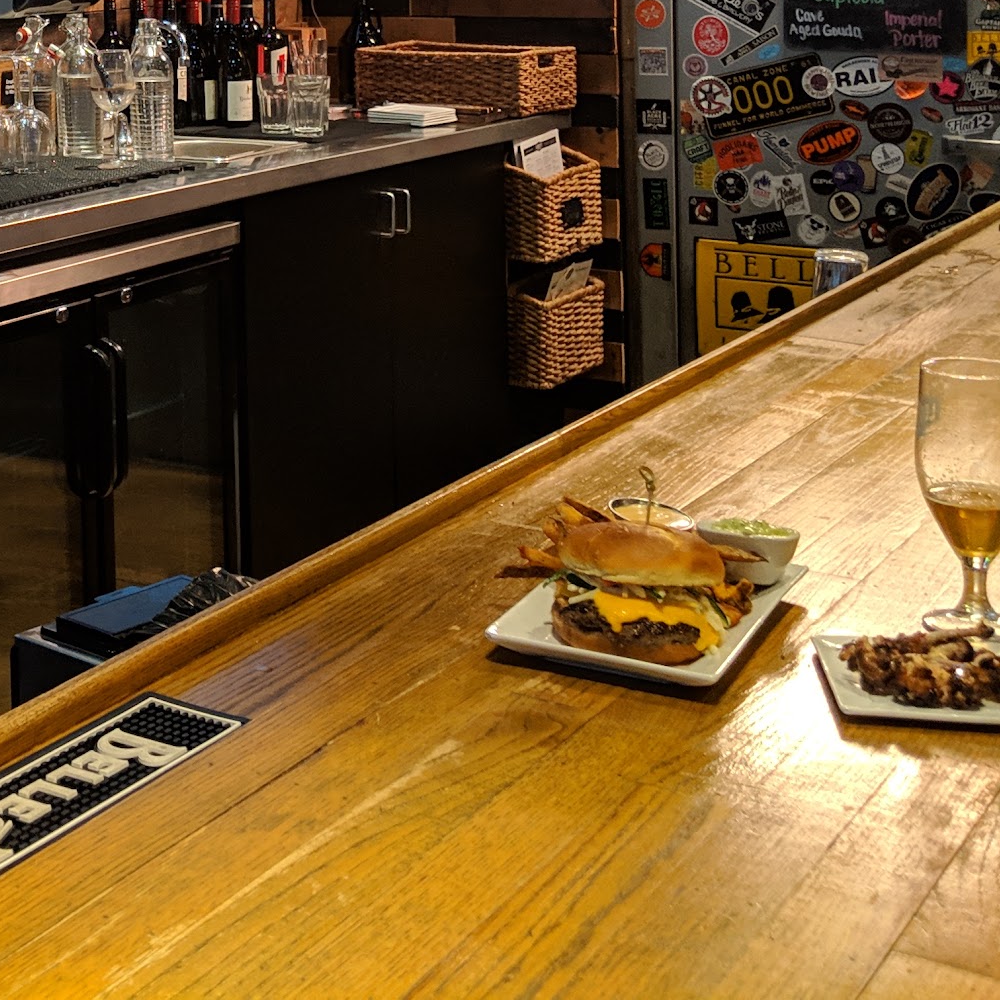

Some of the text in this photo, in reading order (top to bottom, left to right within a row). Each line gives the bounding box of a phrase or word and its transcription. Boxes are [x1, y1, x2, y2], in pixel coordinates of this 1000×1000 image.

[795, 8, 825, 23] Cave
[884, 10, 943, 30] Imperial
[789, 24, 863, 40] Aged Gouda
[892, 29, 942, 47] Porter
[726, 64, 789, 85] CANAL ZONE
[733, 75, 794, 114] 000
[713, 119, 741, 130] FUNNEL
[743, 114, 757, 124] FOR
[758, 109, 785, 120] WORLD
[800, 127, 857, 159] PUMP
[757, 218, 785, 232] STONE
